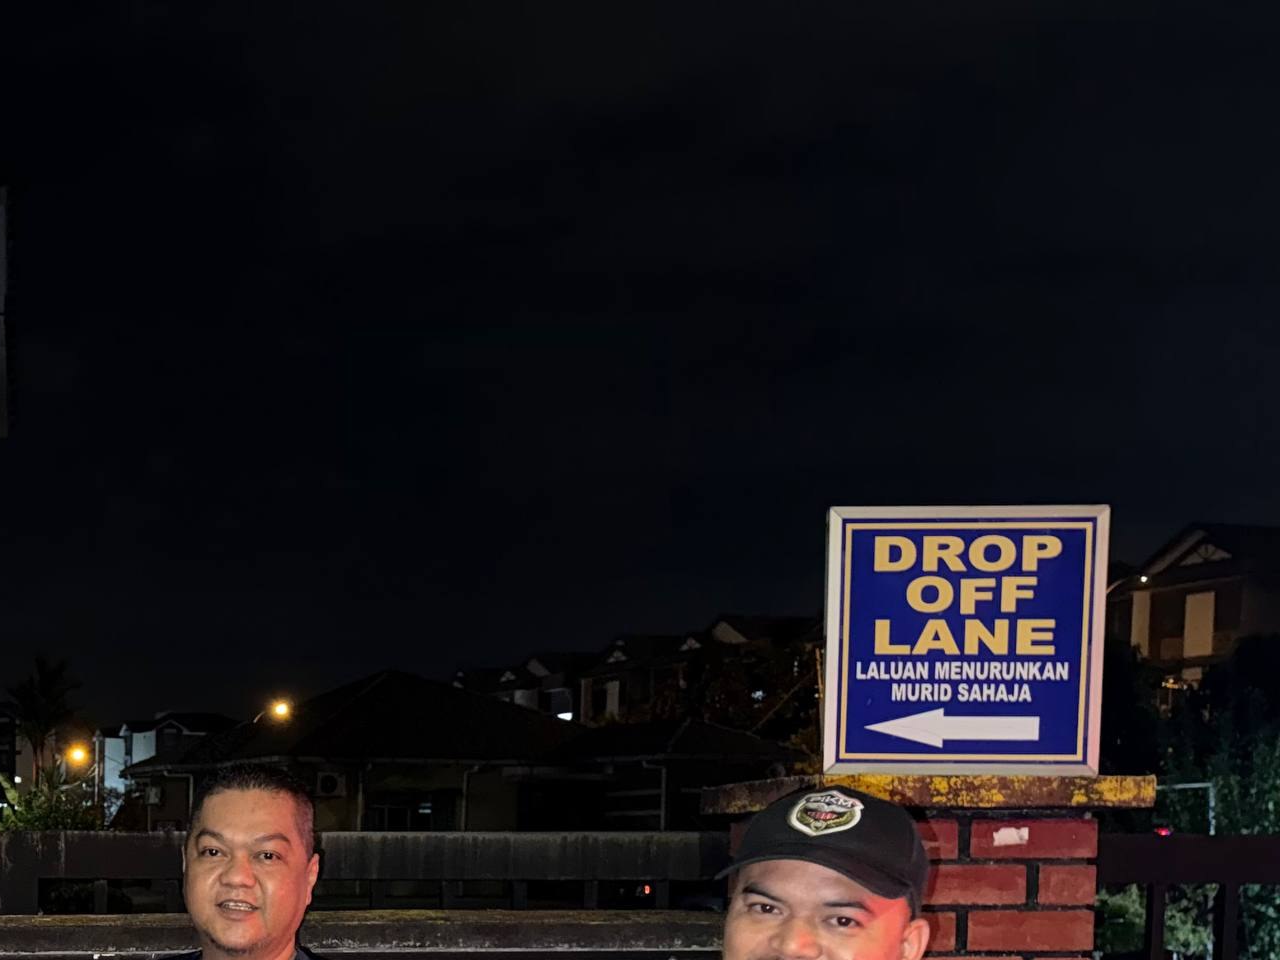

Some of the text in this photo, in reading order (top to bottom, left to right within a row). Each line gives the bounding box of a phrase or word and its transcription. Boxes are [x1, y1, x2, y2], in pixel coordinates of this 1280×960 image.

[873, 535, 1063, 573] DROP
[906, 576, 1038, 615] OFF
[874, 619, 1056, 656] LANE
[856, 661, 1069, 681] LALUAN MENURUNKAN
[891, 683, 1032, 702] MURID SAHAJA
